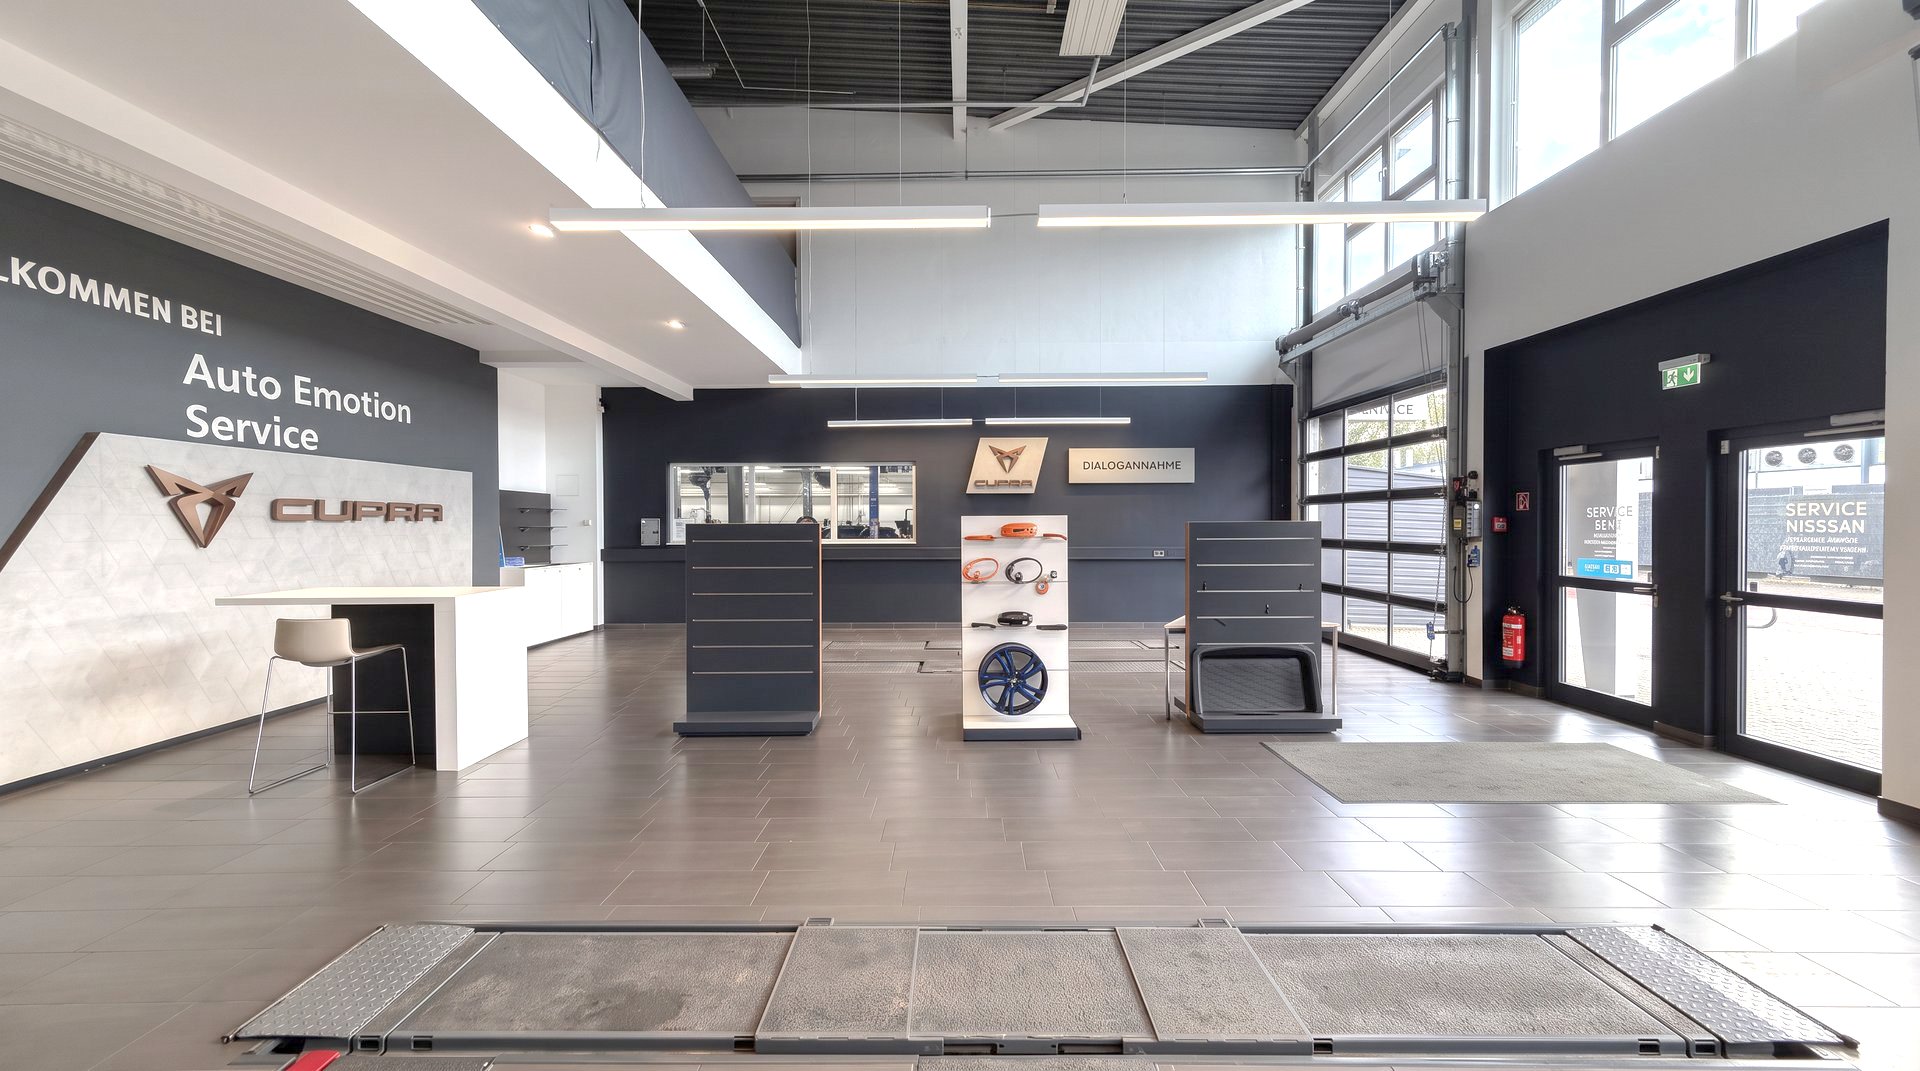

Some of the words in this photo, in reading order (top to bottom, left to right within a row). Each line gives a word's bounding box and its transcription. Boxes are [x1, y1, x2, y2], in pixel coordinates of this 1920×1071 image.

[181, 304, 222, 337] BEI
[183, 353, 282, 401] Auto
[294, 374, 412, 424] Emotion
[185, 404, 319, 451] Service
[1082, 460, 1182, 471] DIALOGANNAHME
[973, 479, 1034, 489] CUPRA
[270, 498, 444, 523] CUPRA
[1785, 501, 1867, 517] SERVICE
